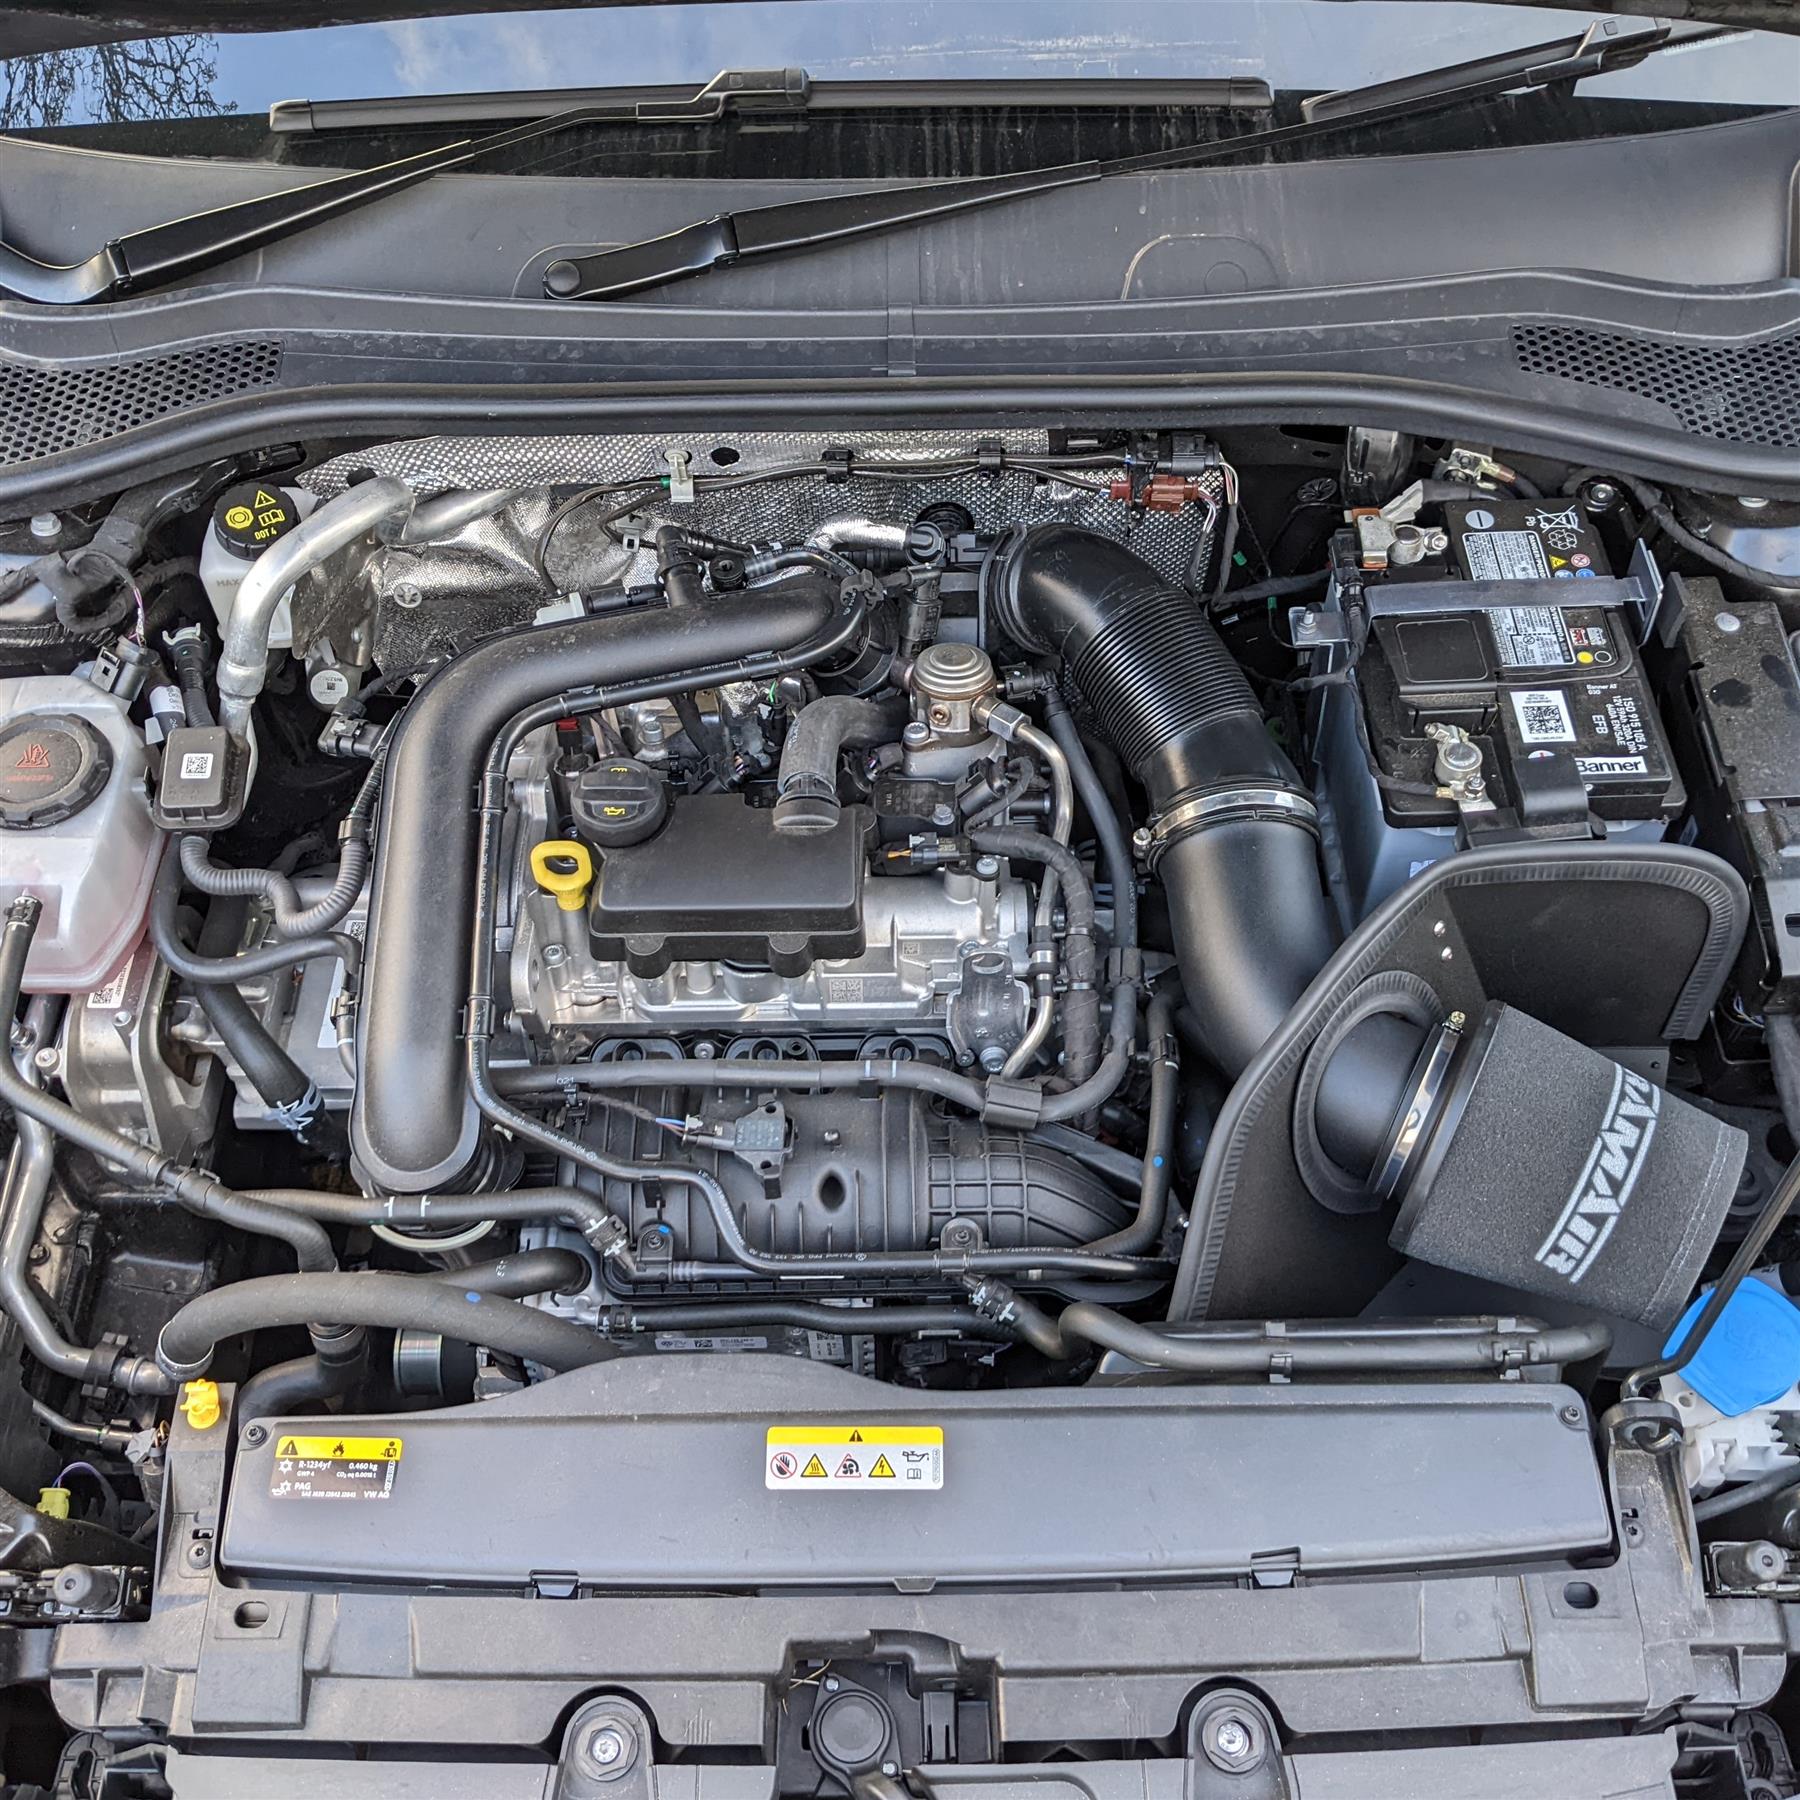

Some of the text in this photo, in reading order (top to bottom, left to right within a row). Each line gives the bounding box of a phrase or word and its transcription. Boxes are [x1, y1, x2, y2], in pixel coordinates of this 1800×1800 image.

[1525, 515, 1536, 526] Pb
[254, 527, 277, 540] DOT 4
[1528, 535, 1546, 578] DANGER/POISO
[1592, 714, 1609, 734] EFB
[1612, 695, 1623, 706] 12V
[1627, 741, 1638, 754] DIN
[1628, 714, 1641, 727] 915
[1611, 719, 1626, 746] EN/SAE
[1633, 729, 1646, 742] 105
[1576, 760, 1641, 773] Banner
[1543, 1067, 1657, 1275] RAMAIR
[298, 1460, 378, 1471] R-1234yf 0.460 kg
[294, 1482, 311, 1490] PAG
[363, 1490, 390, 1498] VW AG
